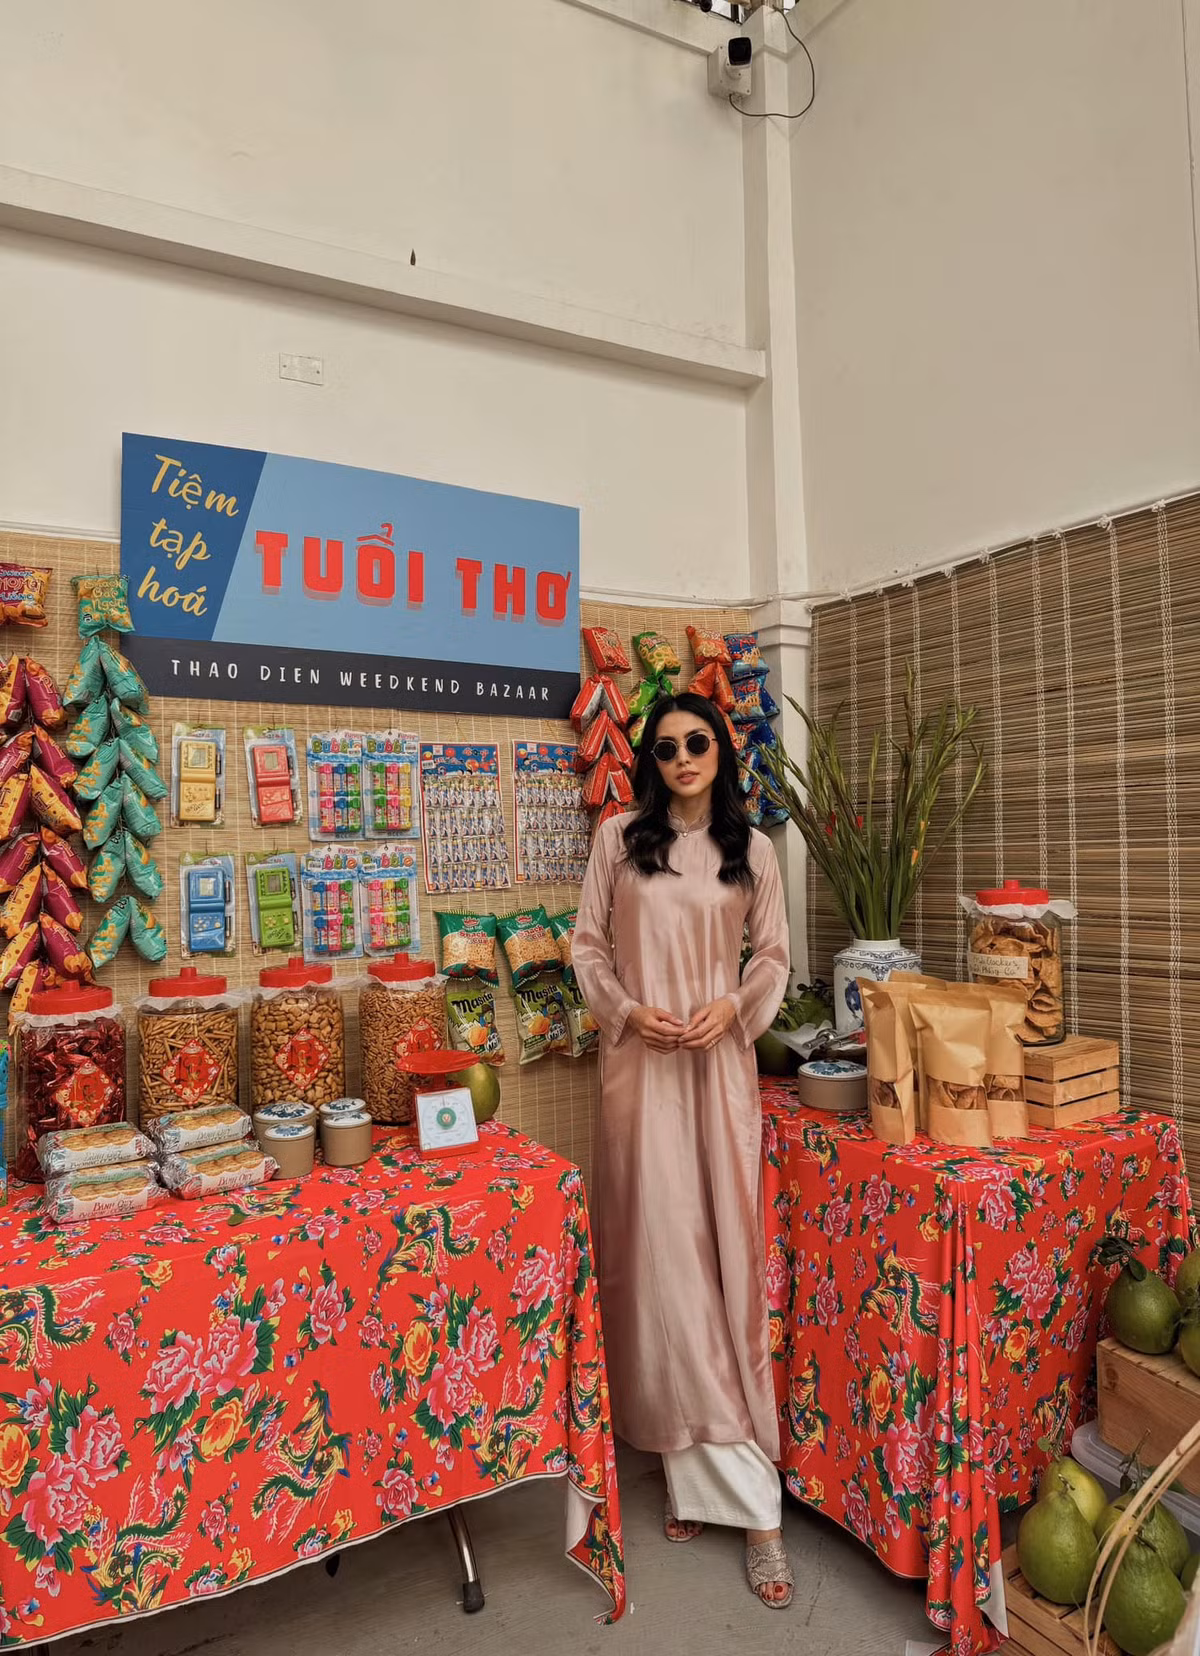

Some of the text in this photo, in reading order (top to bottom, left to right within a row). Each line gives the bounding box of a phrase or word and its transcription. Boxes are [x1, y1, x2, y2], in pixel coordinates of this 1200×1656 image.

[152, 454, 239, 517] Tiệm
[150, 518, 211, 570] tạp
[137, 566, 207, 616] hoá
[255, 523, 572, 623] TUỔI THƠ
[171, 659, 549, 700] THAO DIEN WEEDKEND BAZAAR
[515, 985, 558, 1006] Masita
